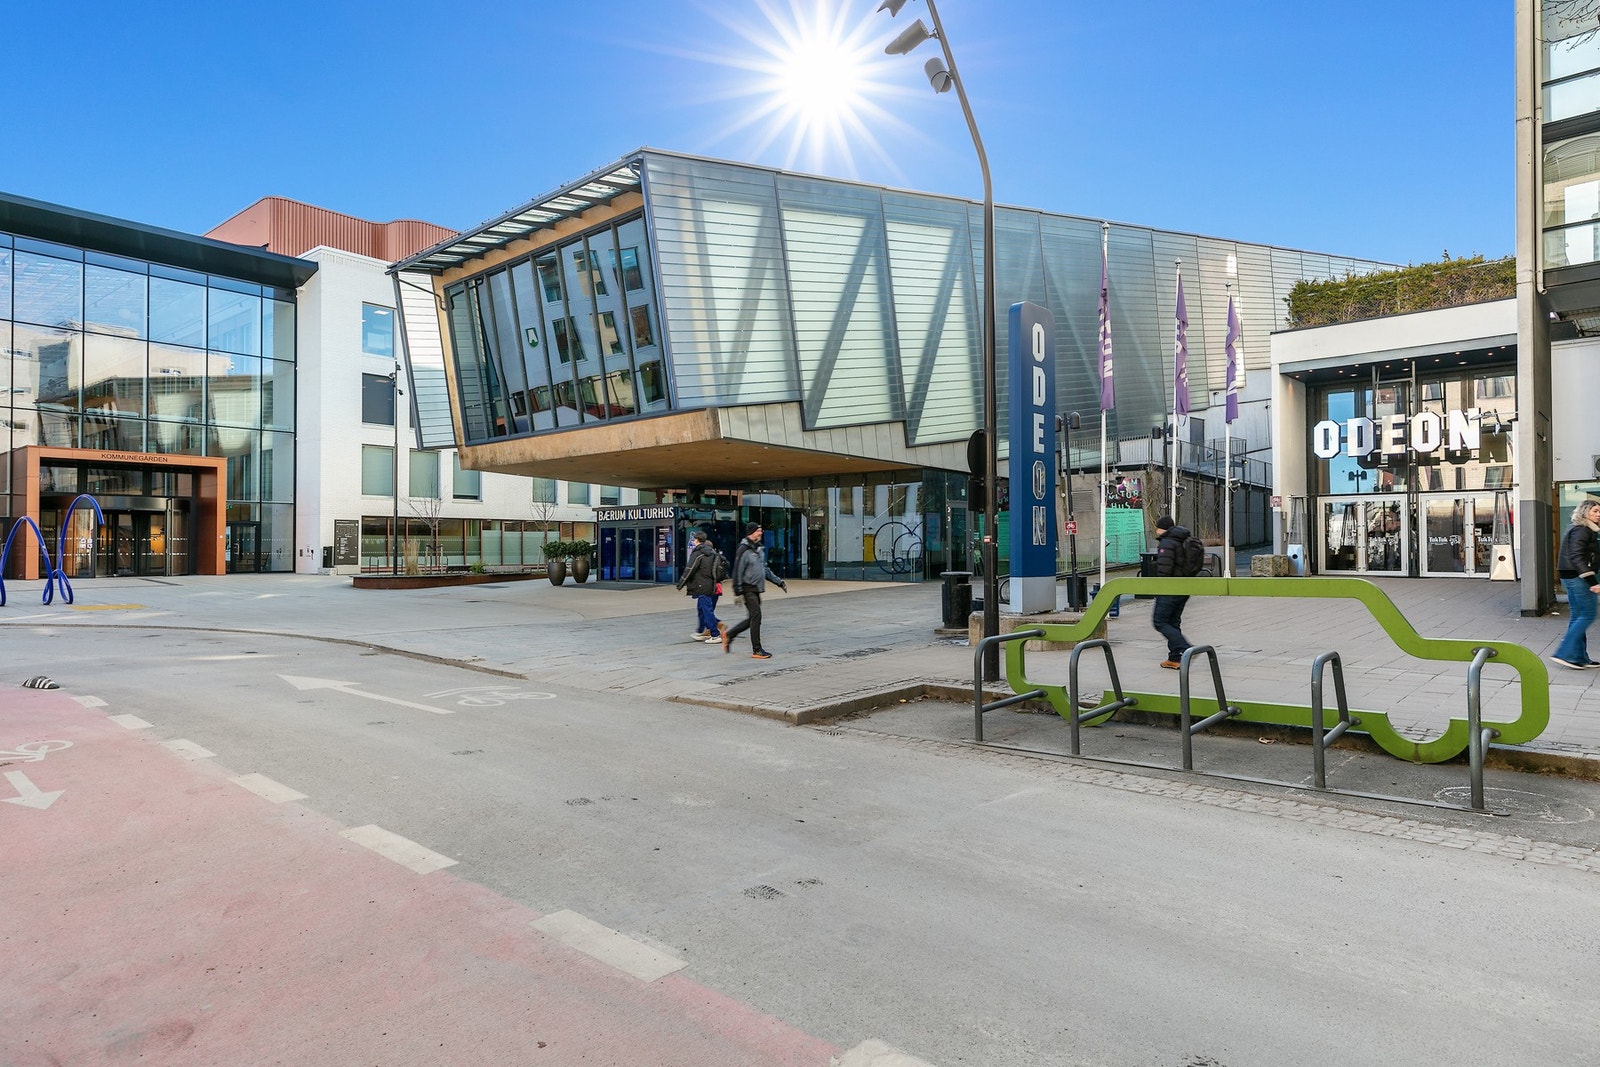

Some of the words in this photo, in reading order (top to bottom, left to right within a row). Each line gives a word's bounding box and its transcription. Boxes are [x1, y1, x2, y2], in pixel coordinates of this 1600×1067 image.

[1032, 322, 1046, 546] ODEON
[1313, 407, 1480, 459] ODEON
[101, 453, 168, 463] KOMMUNEGÅRDEN
[598, 509, 626, 521] BÆRUM
[628, 506, 675, 520] KULTURHUS
